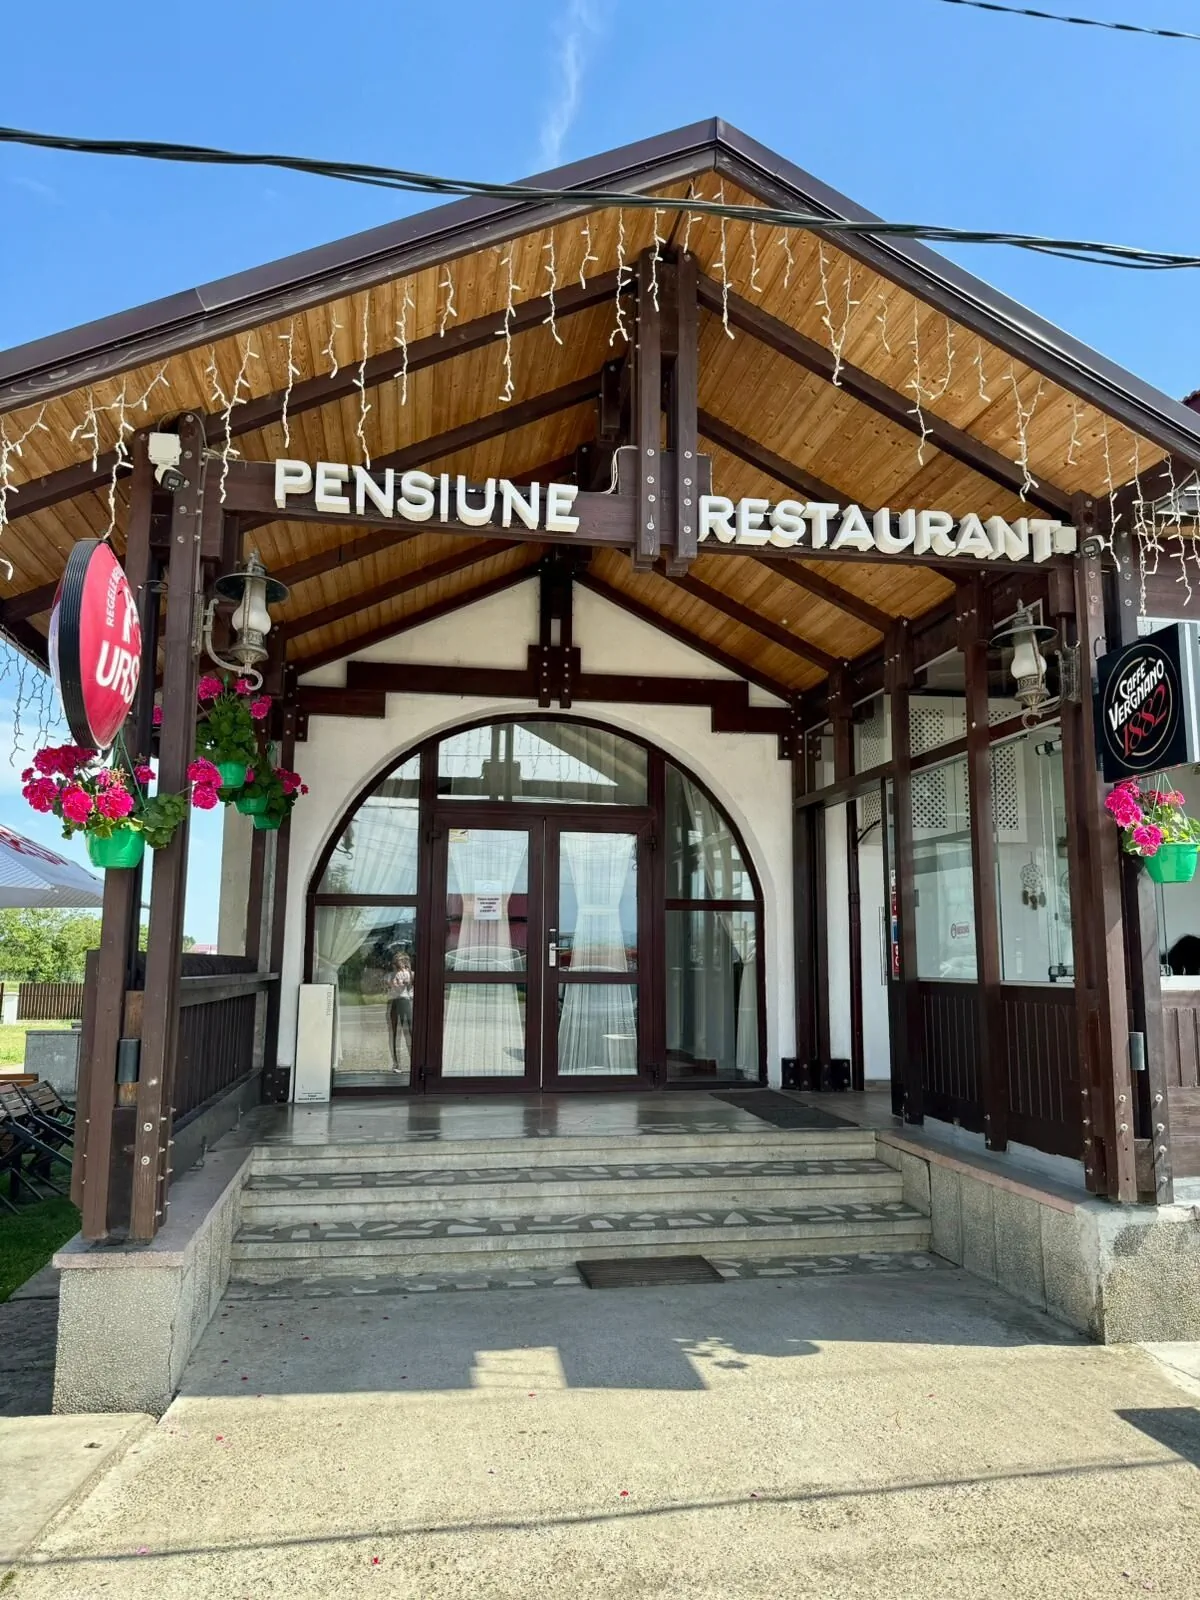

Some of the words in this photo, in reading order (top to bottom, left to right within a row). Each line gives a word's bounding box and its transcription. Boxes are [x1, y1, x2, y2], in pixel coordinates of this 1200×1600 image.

[274, 458, 580, 533] PENSIUNE
[697, 494, 1063, 564] RESTAURANT
[1108, 659, 1164, 731] VERGNANO
[1122, 684, 1168, 760] 1882
